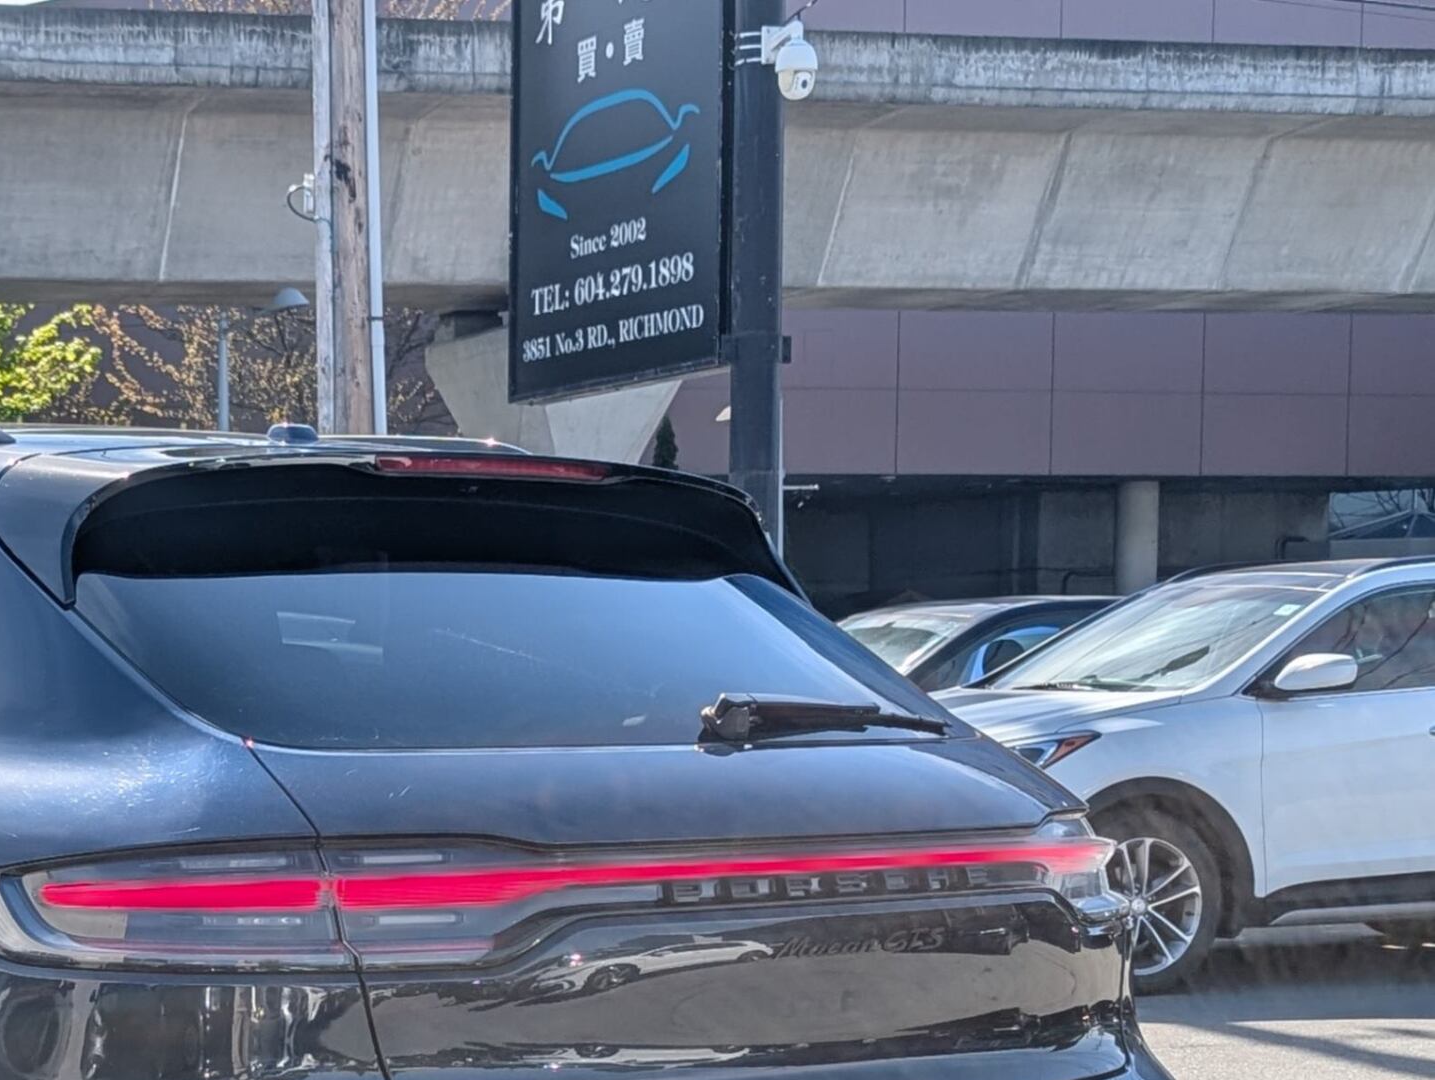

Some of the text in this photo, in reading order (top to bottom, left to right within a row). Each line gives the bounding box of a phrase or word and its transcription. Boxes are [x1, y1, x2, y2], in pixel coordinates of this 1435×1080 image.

[570, 216, 646, 259] Since 2002
[531, 252, 695, 316] TEL: 604.279.1898
[523, 336, 551, 362] 3851
[619, 304, 704, 343] RICHMOND
[670, 866, 989, 902] PORSCHE
[884, 926, 945, 951] GTS
